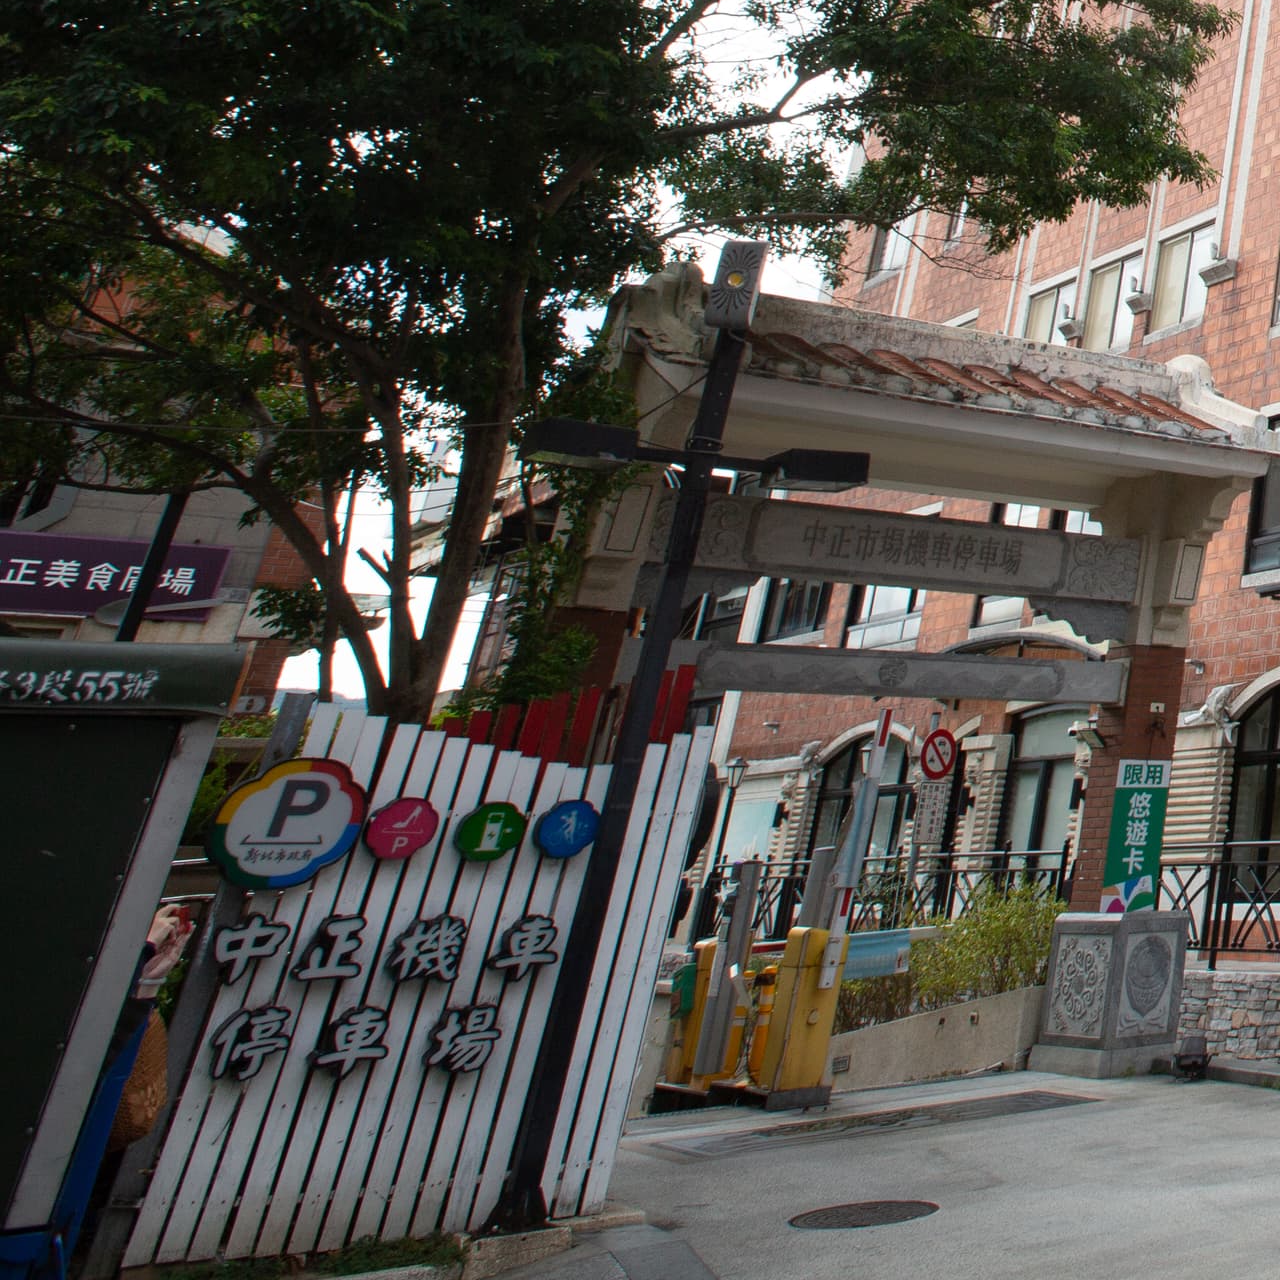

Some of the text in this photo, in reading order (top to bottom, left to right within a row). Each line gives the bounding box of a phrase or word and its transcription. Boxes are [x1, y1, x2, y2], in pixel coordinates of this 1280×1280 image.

[802, 518, 1025, 576] 中正市場機車停車場
[0, 670, 160, 703] 3段55號
[1122, 764, 1164, 786] 限用
[267, 779, 332, 839] P
[1122, 791, 1152, 875] 悠遊卡
[390, 835, 409, 855] P
[214, 913, 559, 985] 中正機車
[212, 1004, 501, 1081] 停車場
